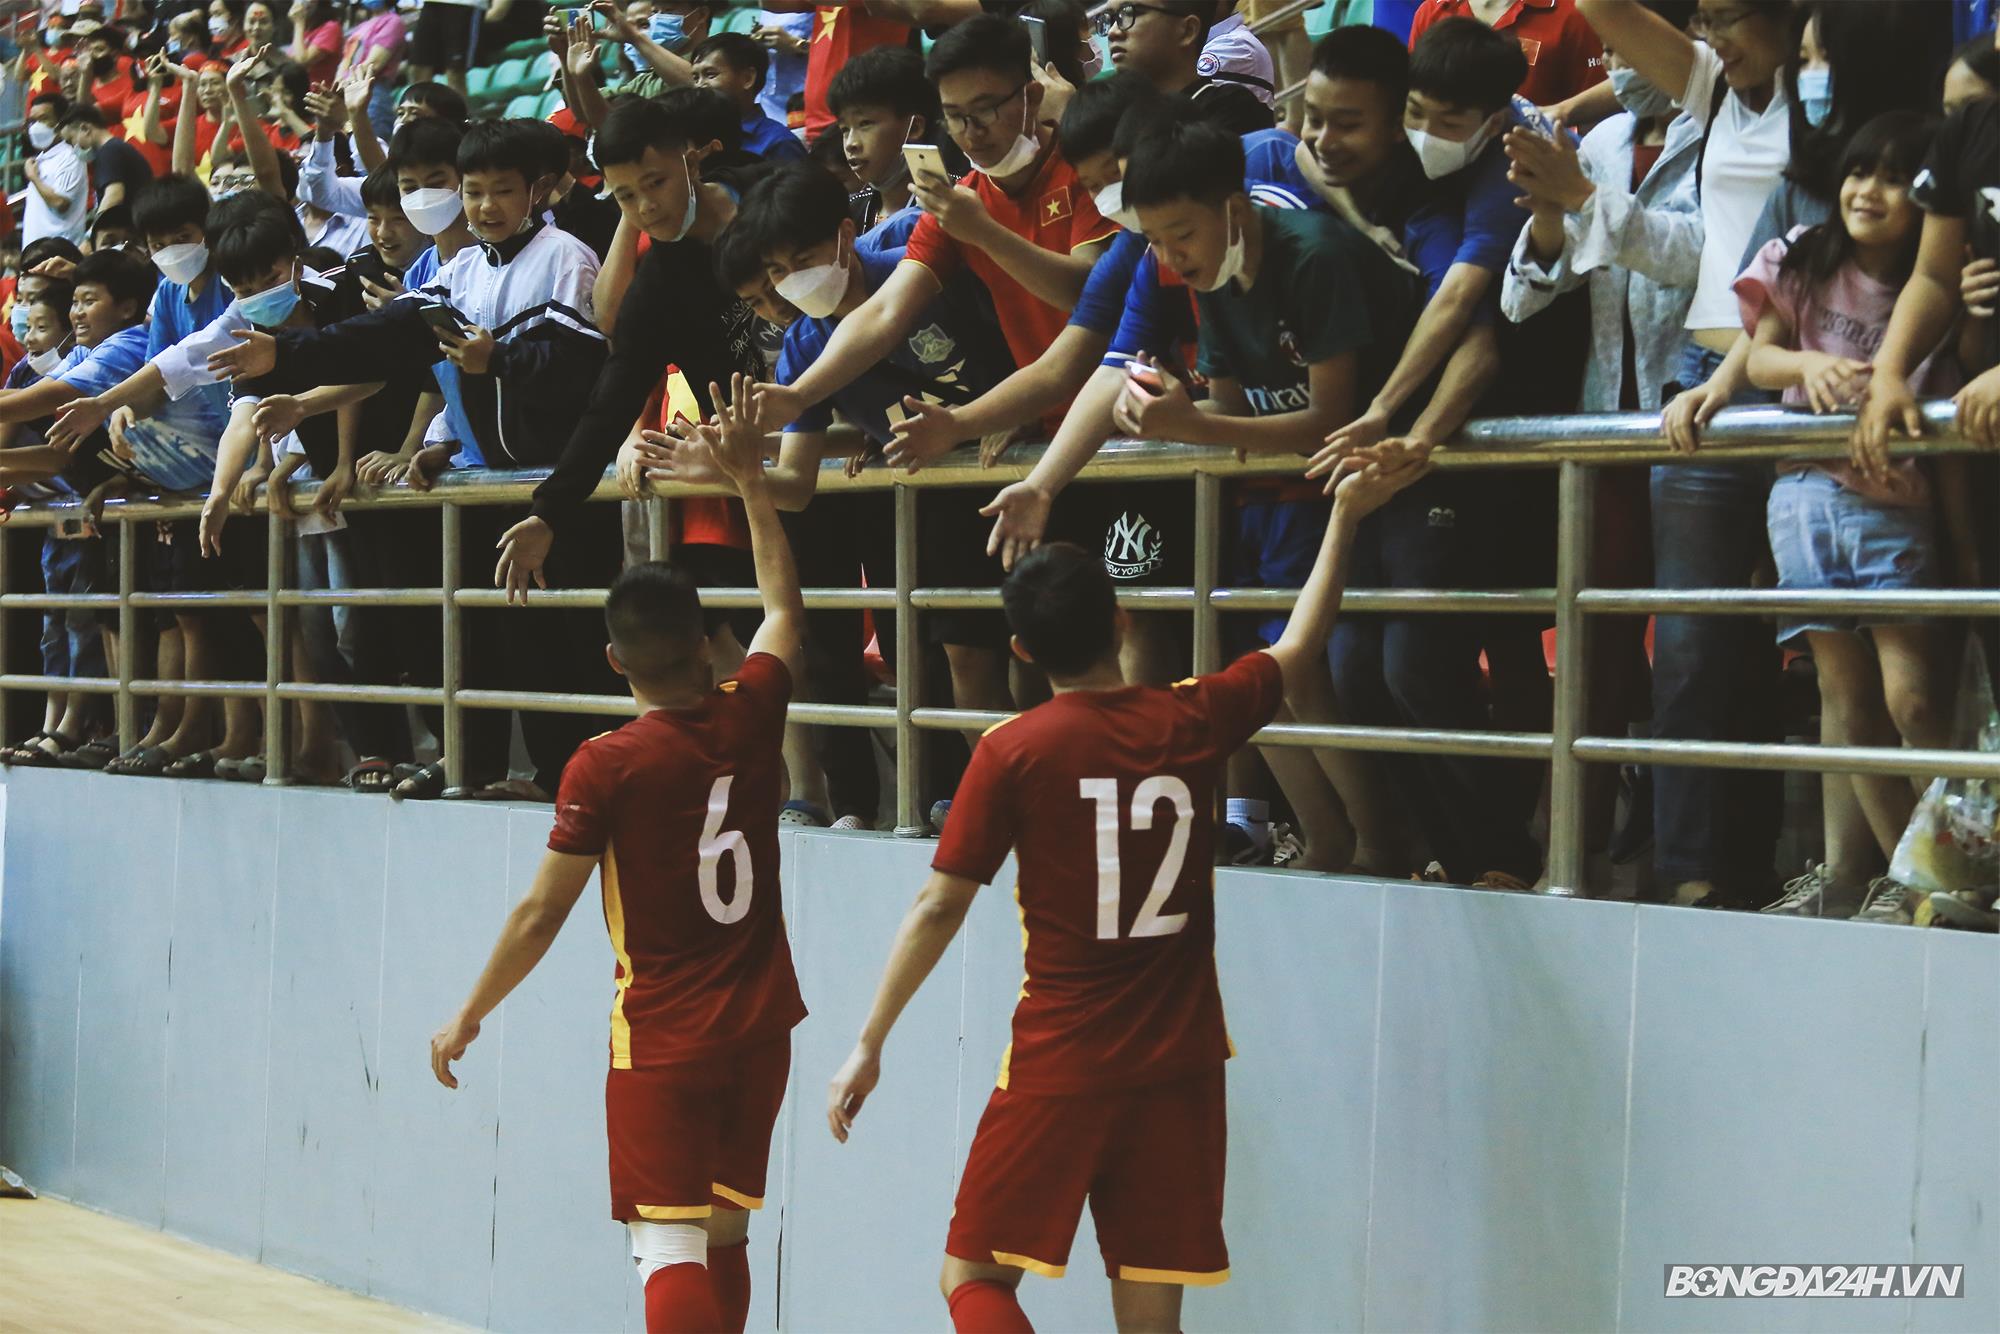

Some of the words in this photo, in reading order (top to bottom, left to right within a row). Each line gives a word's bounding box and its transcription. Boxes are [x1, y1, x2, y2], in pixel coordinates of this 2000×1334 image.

[1587, 57, 1602, 67] Ho
[1121, 565, 1145, 576] YORK
[698, 775, 754, 924] 6
[1079, 775, 1195, 939] 12
